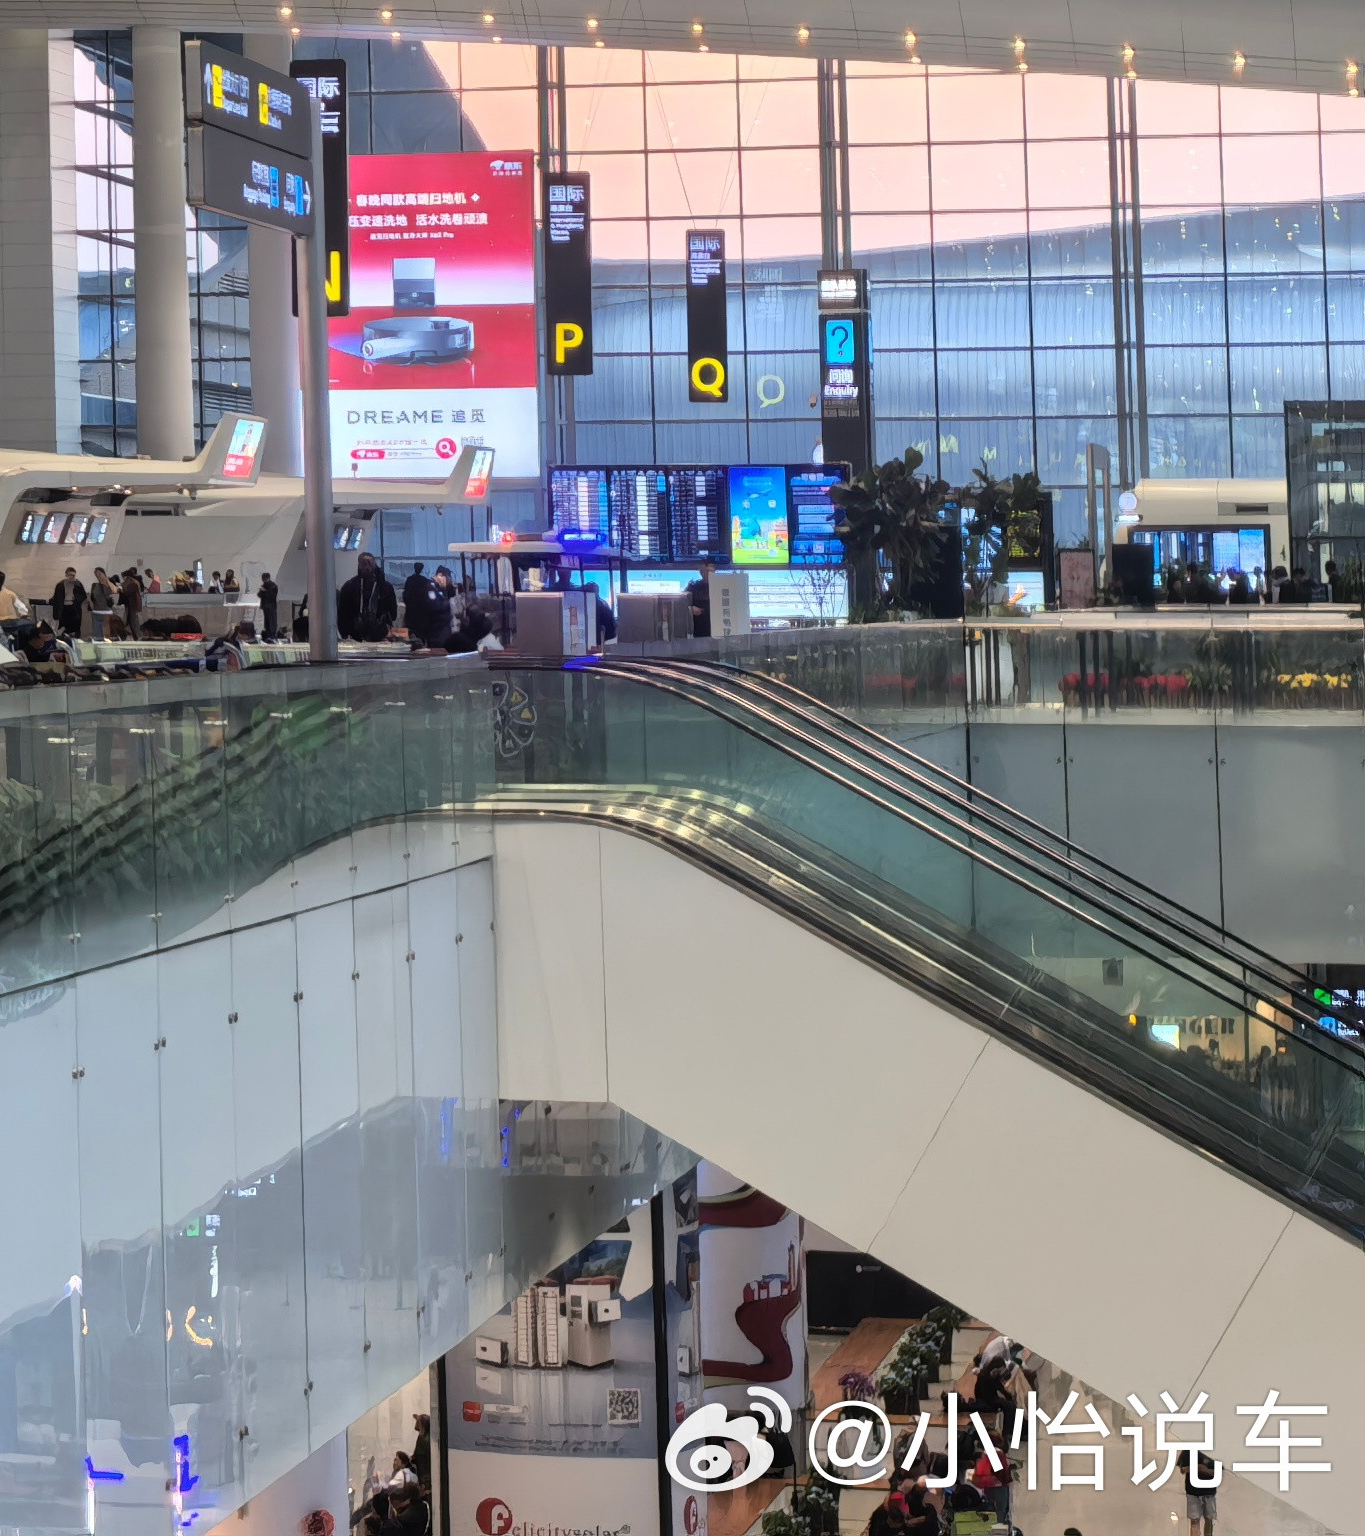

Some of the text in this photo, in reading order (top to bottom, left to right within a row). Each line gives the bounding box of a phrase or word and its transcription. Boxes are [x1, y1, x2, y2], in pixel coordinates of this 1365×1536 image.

[549, 185, 584, 202] 国际
[555, 322, 584, 364] P
[691, 357, 725, 397] Q
[824, 384, 858, 398] Enquiry
[347, 409, 443, 425] DREAME
